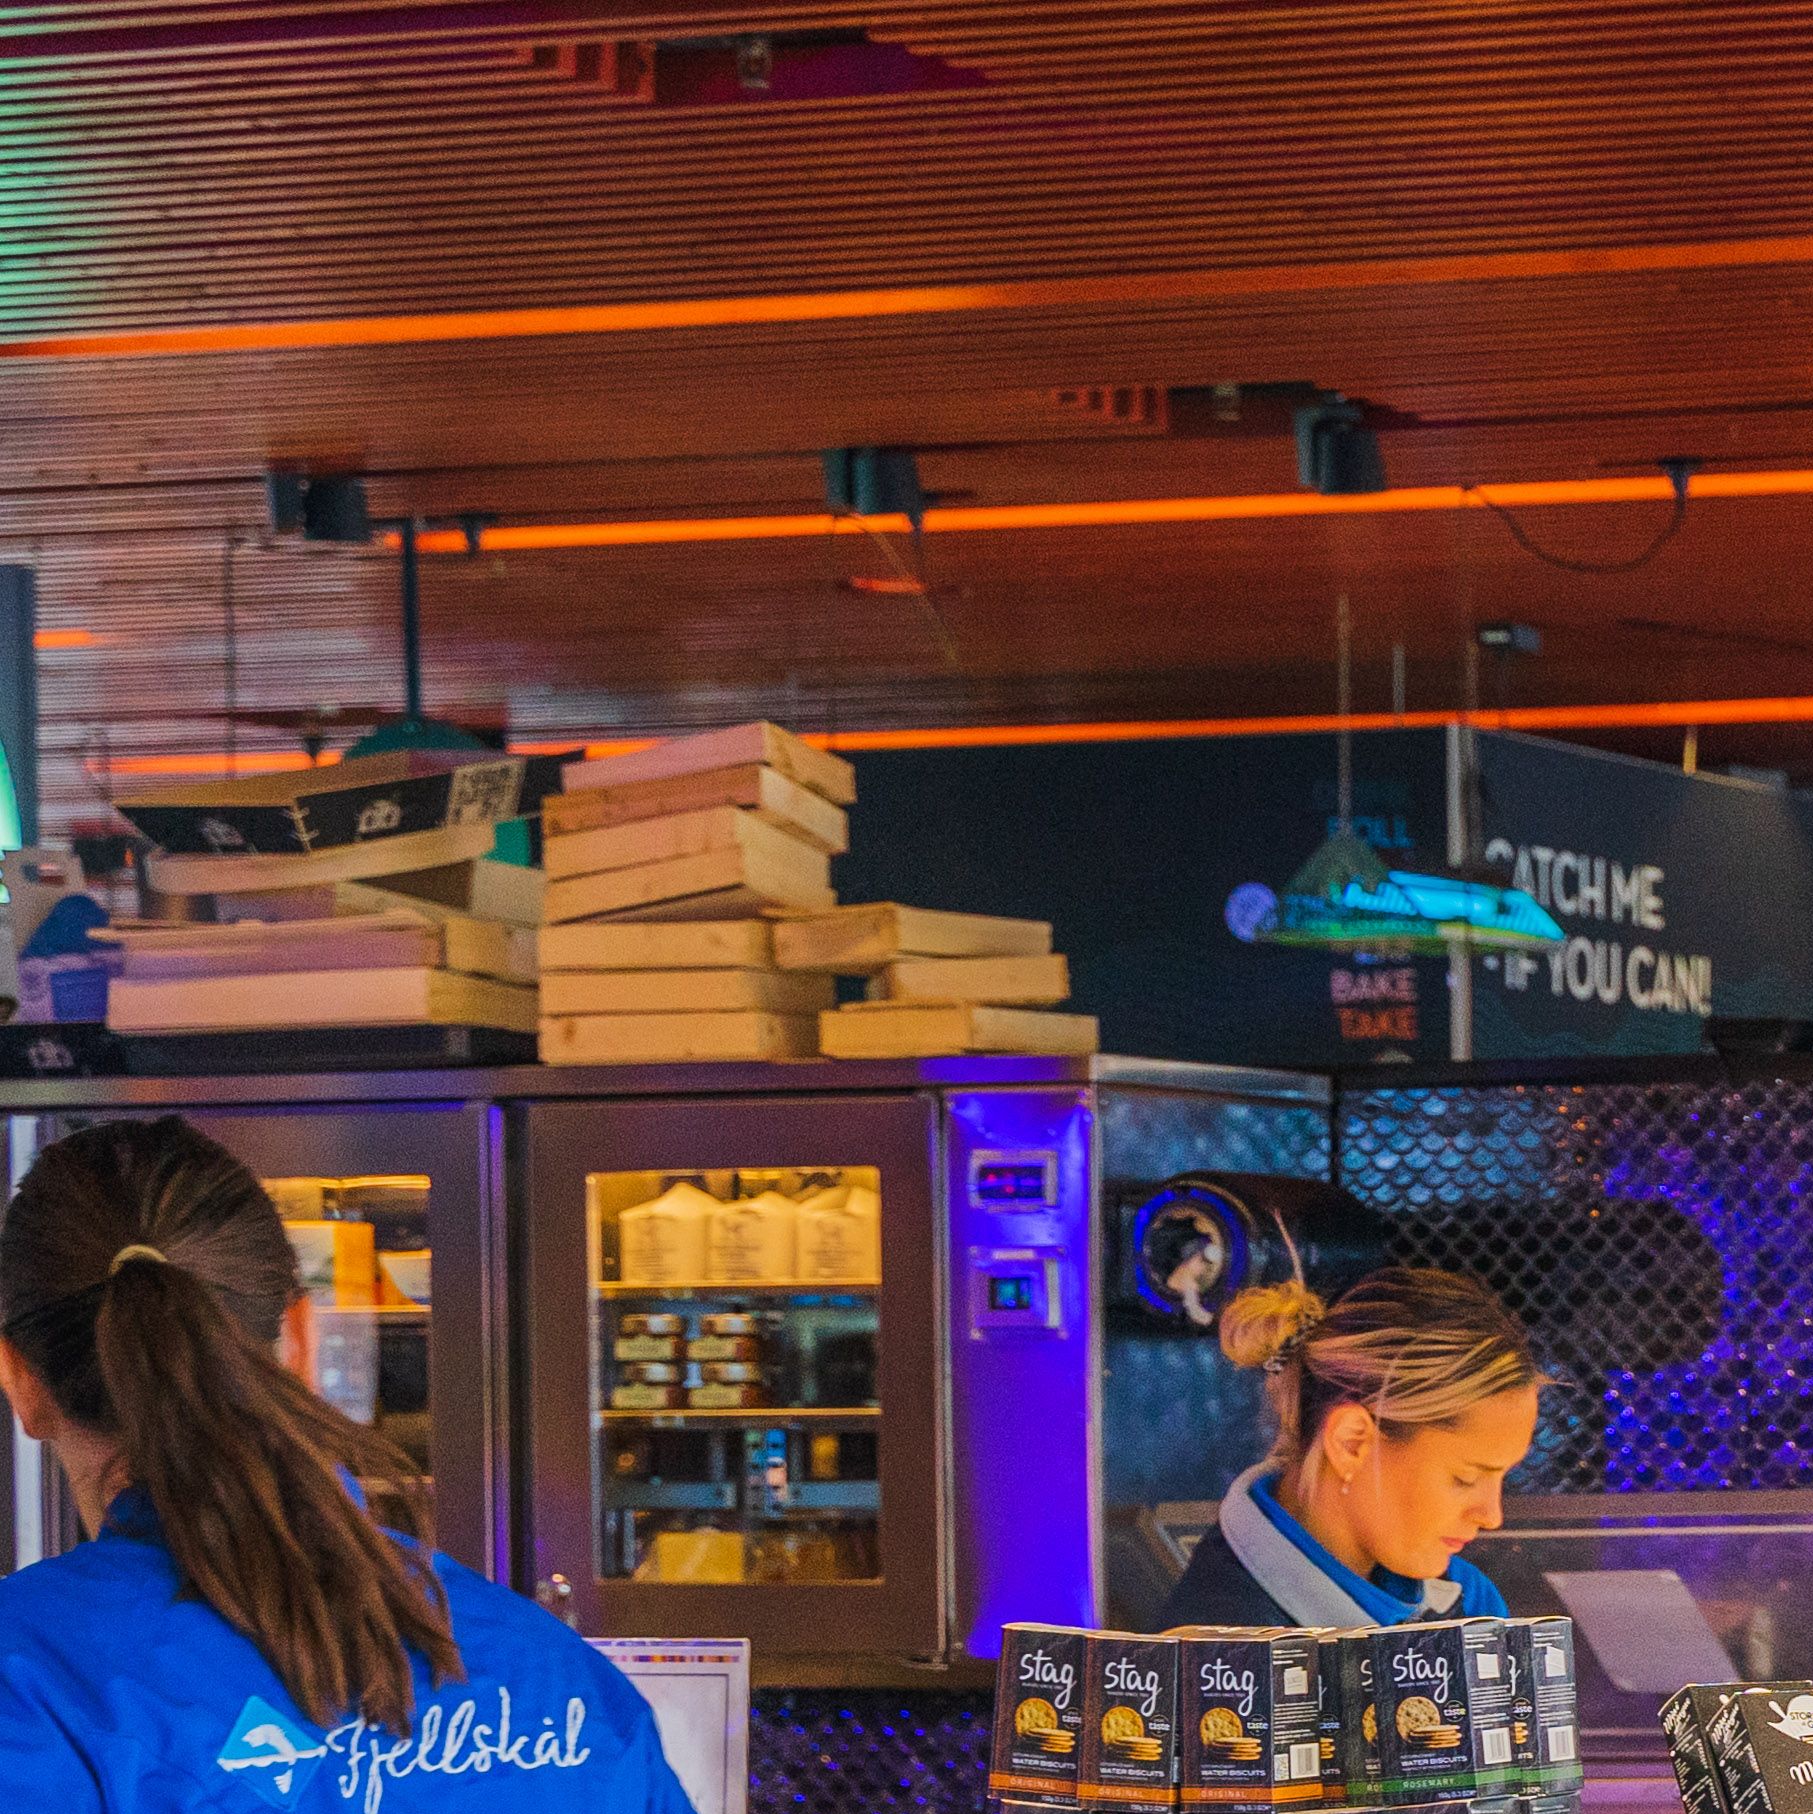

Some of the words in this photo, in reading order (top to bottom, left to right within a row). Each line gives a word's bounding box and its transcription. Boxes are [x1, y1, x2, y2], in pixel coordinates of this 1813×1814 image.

[1609, 860, 1665, 931] ME
[1548, 936, 1622, 1005] YOU
[1626, 944, 1713, 1018] CAN!
[1018, 1649, 1077, 1709] Stag
[1104, 1657, 1162, 1717] Stag
[1201, 1658, 1259, 1716] Stag
[1392, 1647, 1455, 1703] Stag
[1401, 1757, 1430, 1766] WATER
[1430, 1755, 1469, 1765] BISCUITS
[1402, 1777, 1456, 1790] ROSEMARY
